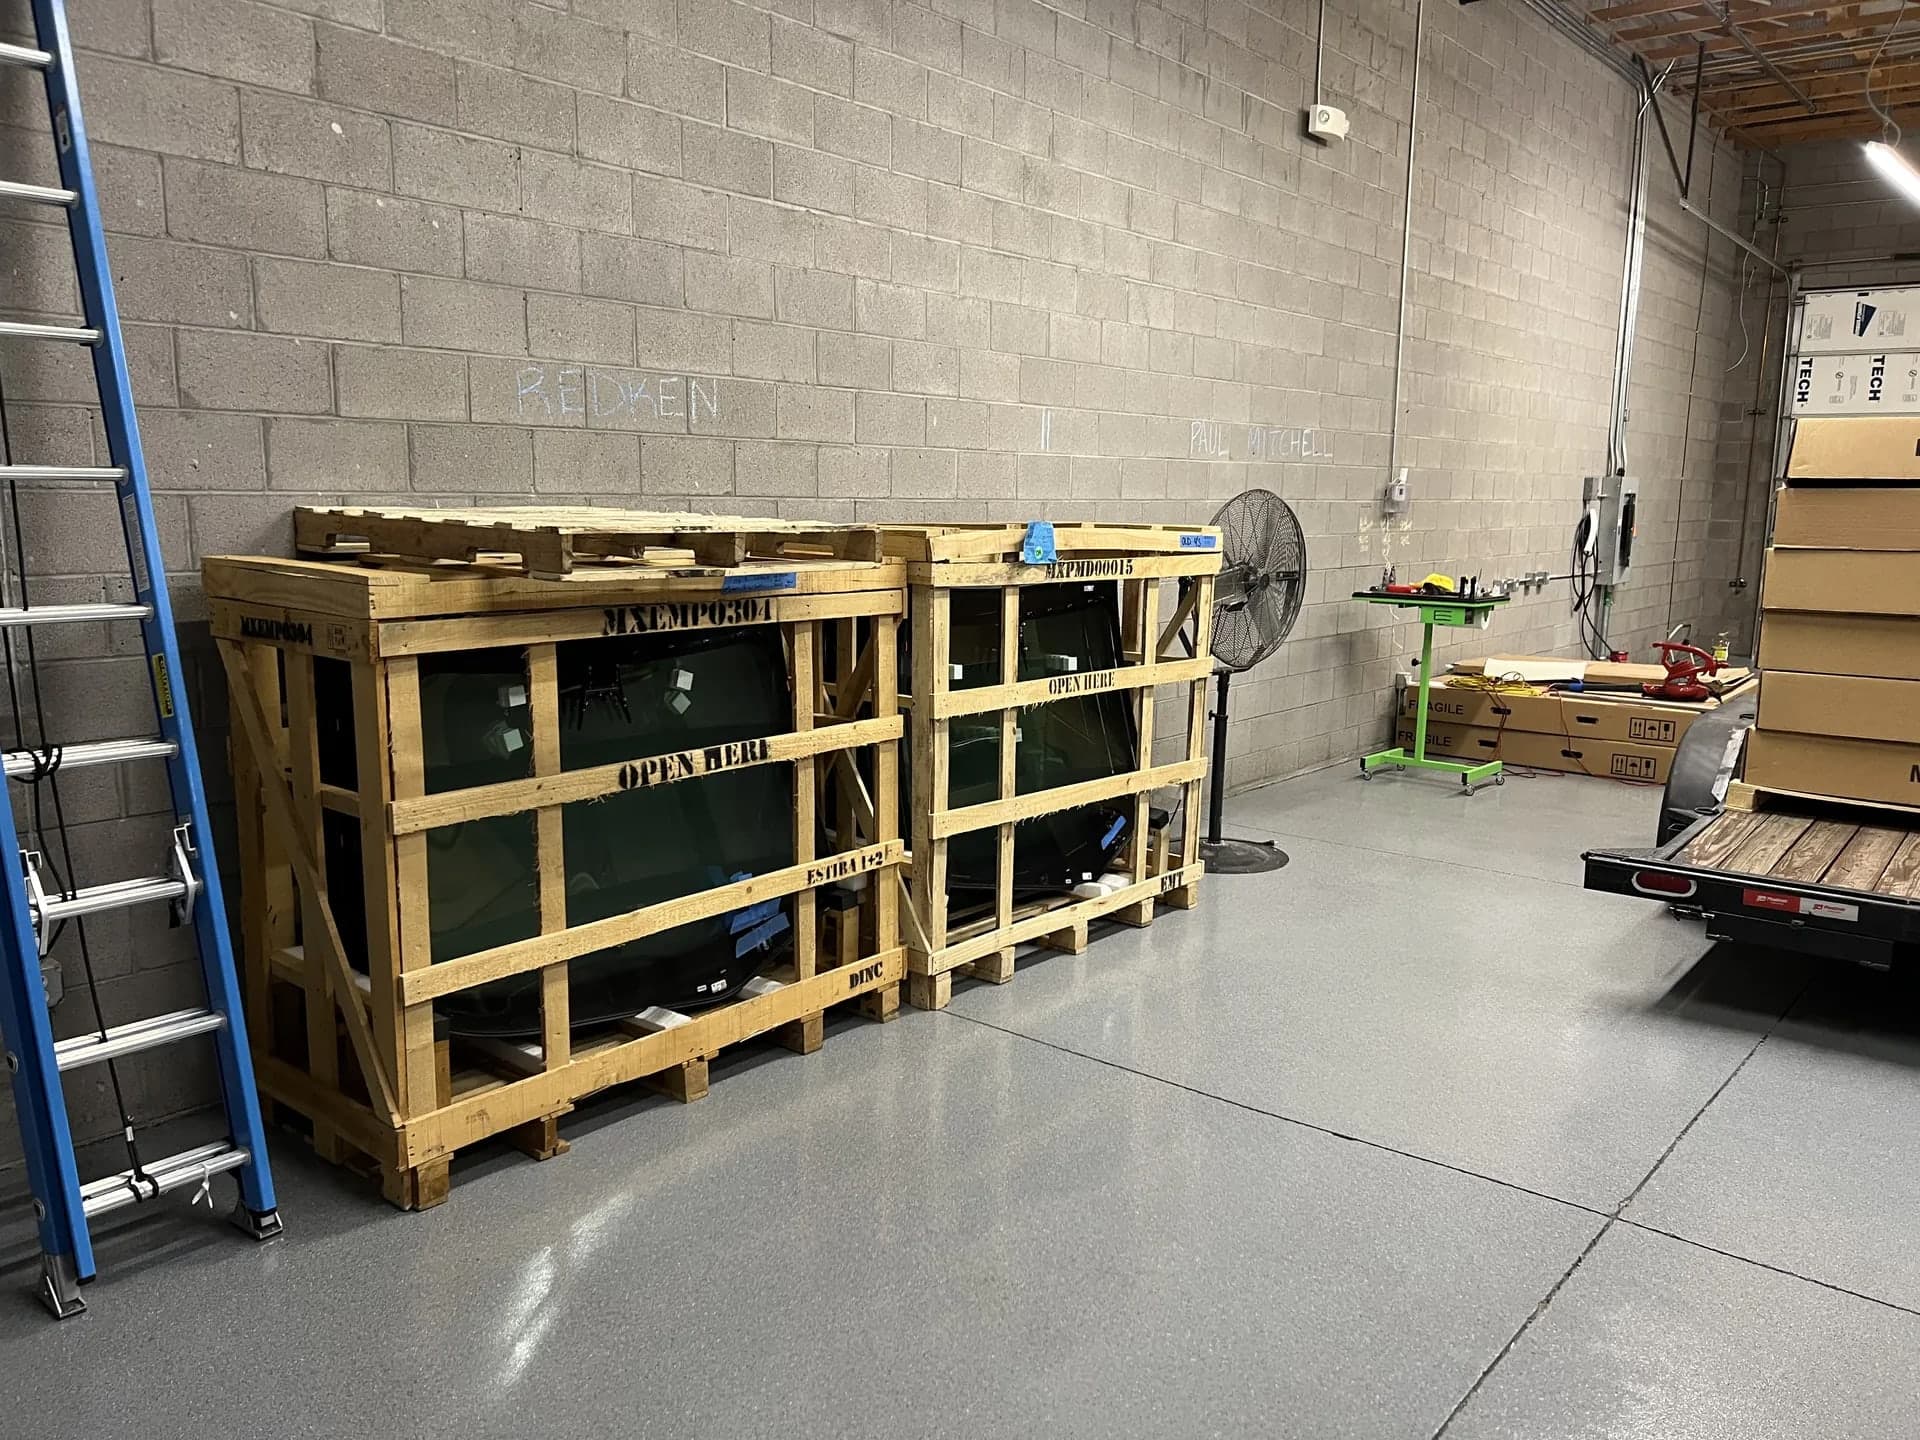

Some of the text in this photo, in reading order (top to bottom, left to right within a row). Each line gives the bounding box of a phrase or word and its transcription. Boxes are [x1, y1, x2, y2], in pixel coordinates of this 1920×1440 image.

[516, 366, 719, 424] REDKEN
[1797, 358, 1813, 402] TECH
[1869, 355, 1885, 400] TECH
[1190, 420, 1334, 457] PAUL MITCHELL
[1045, 558, 1134, 579] MXPMD00015
[602, 598, 772, 636] MXEMP0304
[1048, 671, 1115, 696] OPEN HERE
[1408, 699, 1465, 715] FAGILE
[1398, 730, 1453, 747] FRGILE
[618, 752, 695, 789] OPEN
[848, 961, 884, 989] DINC
